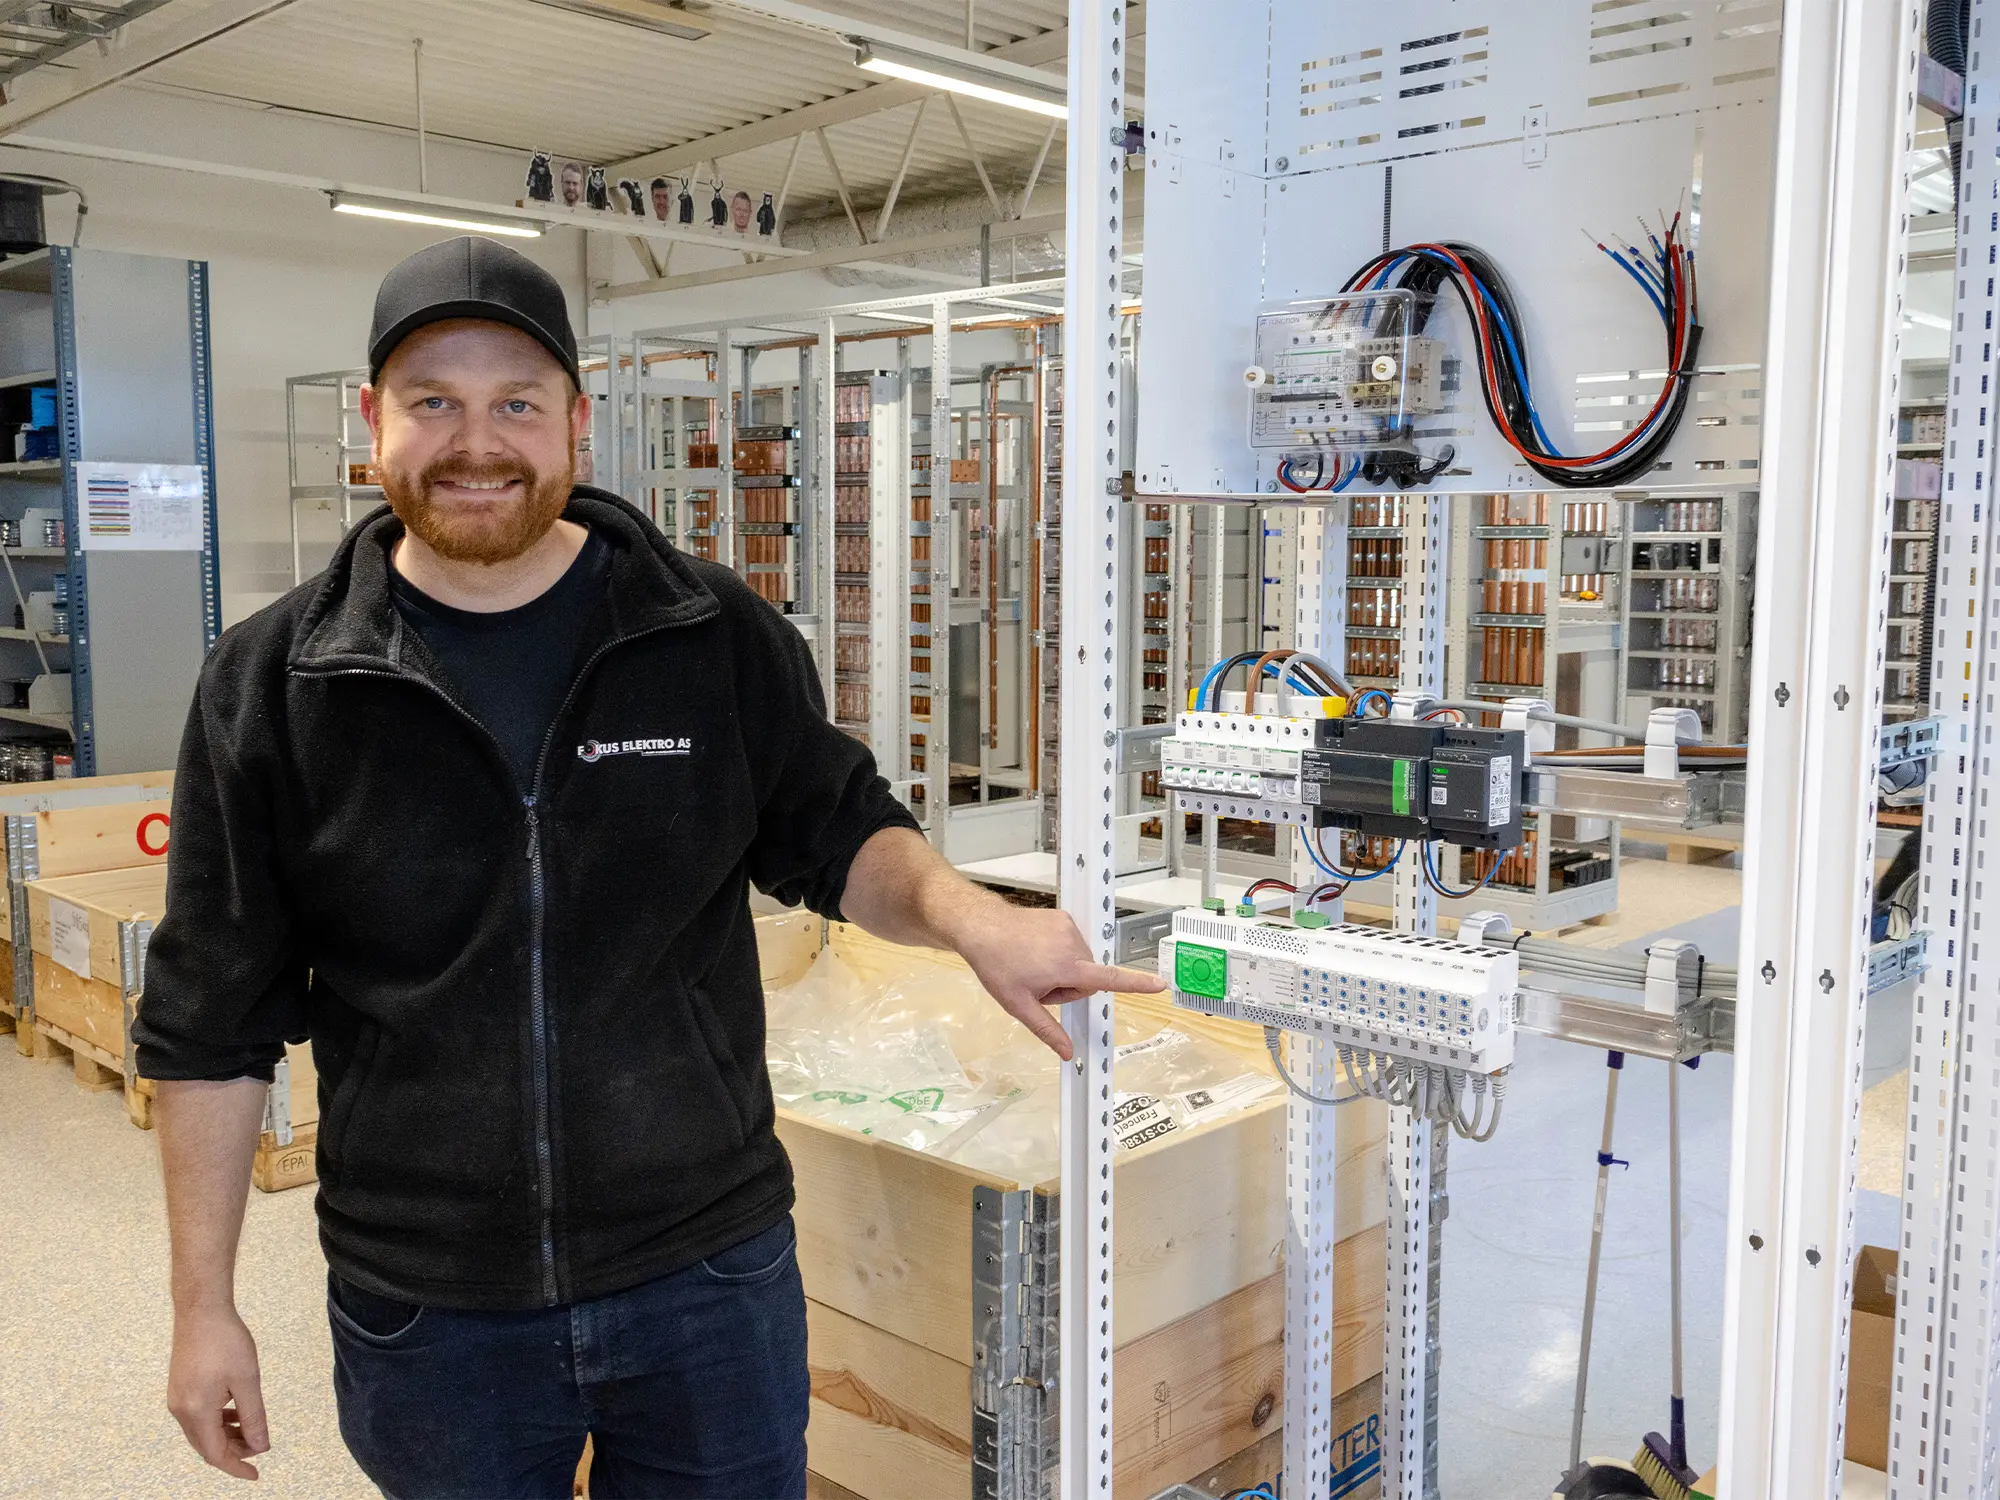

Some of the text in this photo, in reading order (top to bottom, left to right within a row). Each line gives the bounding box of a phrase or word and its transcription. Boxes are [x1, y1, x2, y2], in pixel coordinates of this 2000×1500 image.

[577, 738, 691, 762] FOKUS ELEKTRO AS
